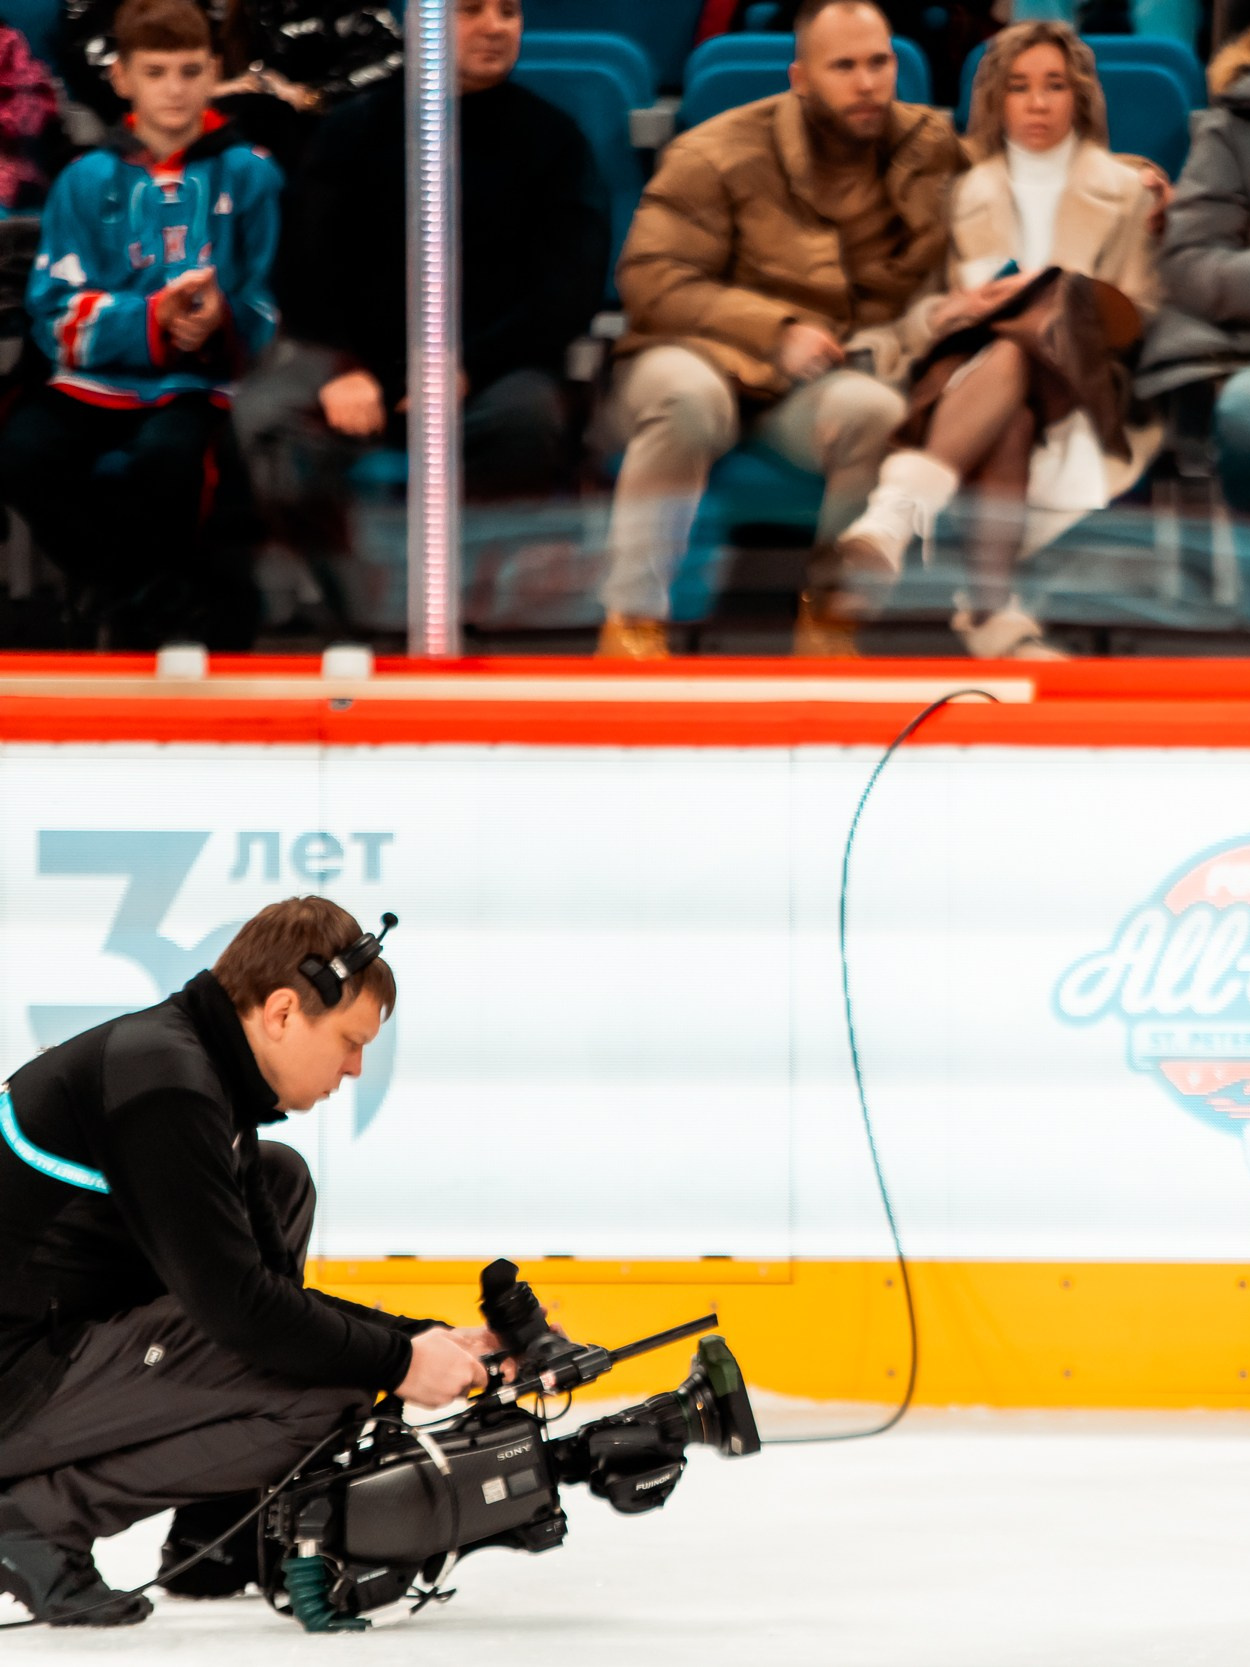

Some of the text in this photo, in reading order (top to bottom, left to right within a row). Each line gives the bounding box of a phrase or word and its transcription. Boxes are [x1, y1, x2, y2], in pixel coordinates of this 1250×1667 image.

[228, 830, 396, 884] лет
[496, 1443, 532, 1461] SONY
[635, 1473, 672, 1491] FUJINON
